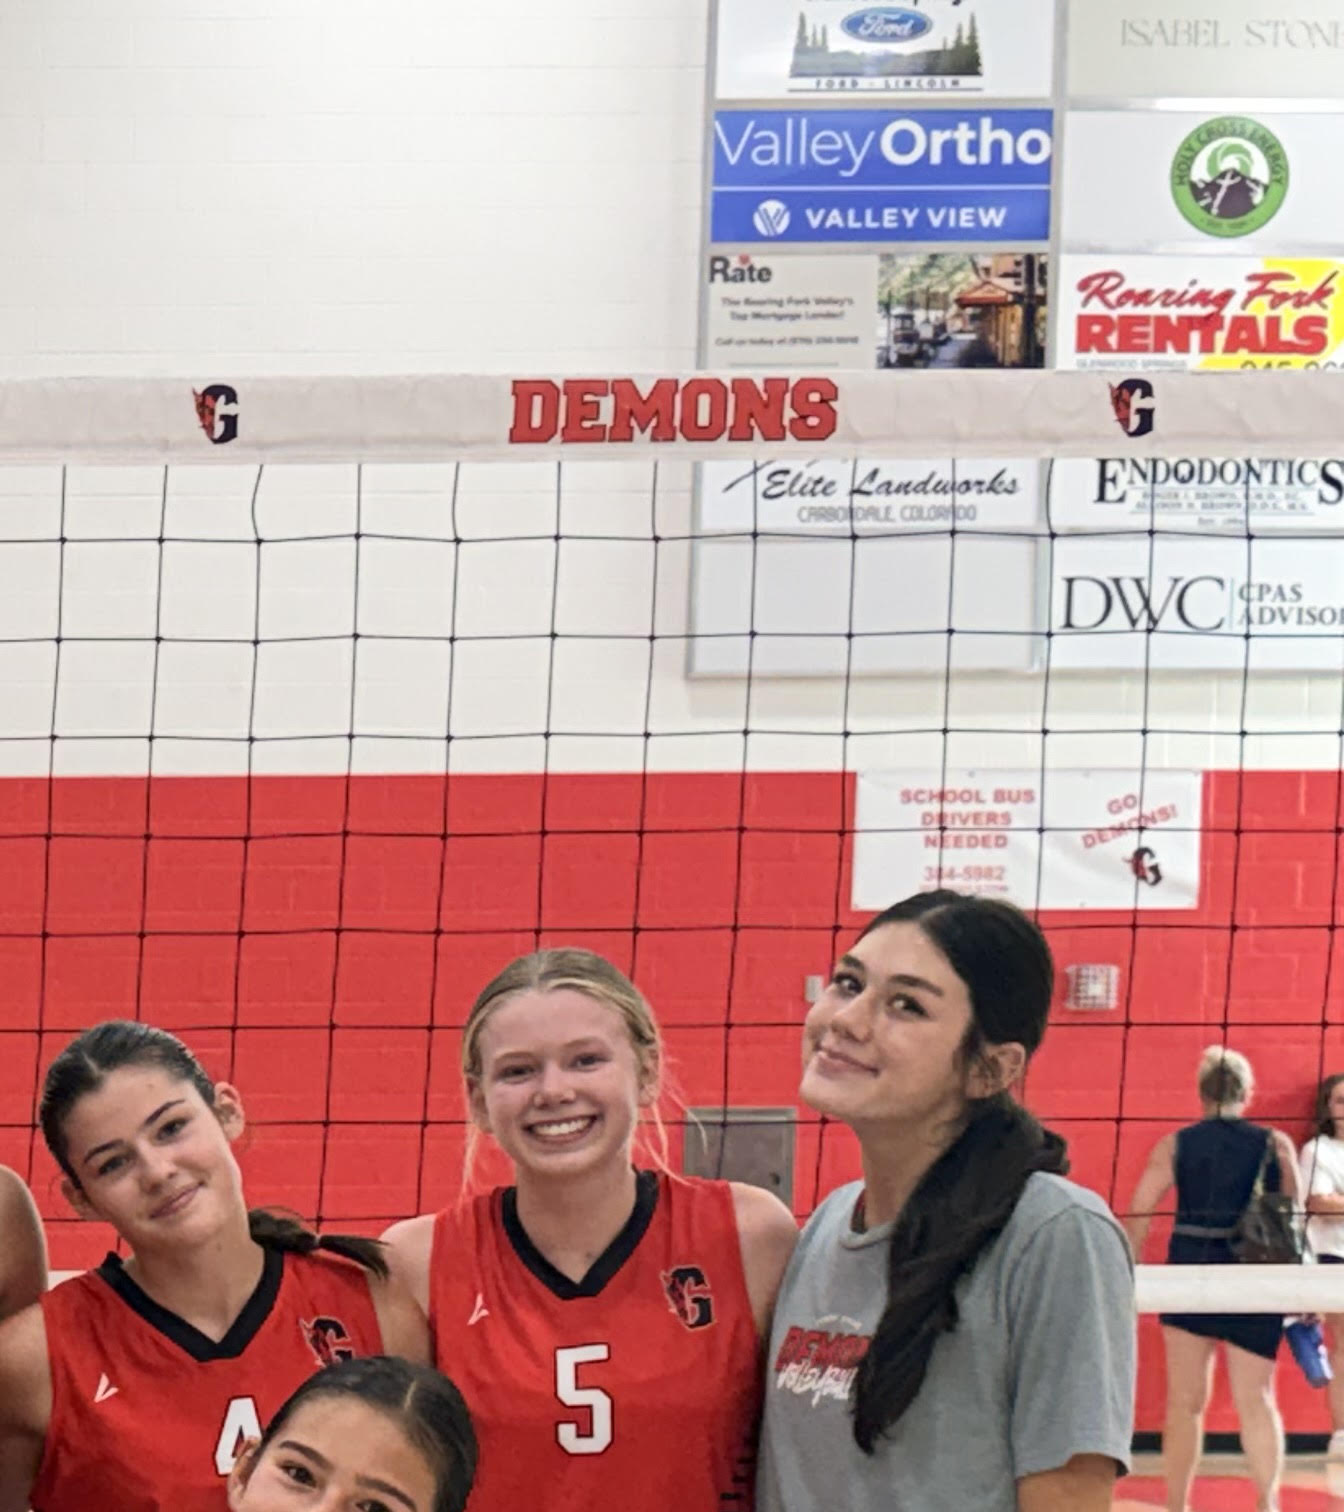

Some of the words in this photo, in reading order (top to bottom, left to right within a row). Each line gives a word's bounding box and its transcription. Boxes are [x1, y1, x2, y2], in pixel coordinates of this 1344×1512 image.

[859, 13, 915, 36] Ford
[1120, 18, 1231, 48] ISABEL
[815, 79, 859, 88] FORD
[714, 117, 875, 177] Valley
[880, 117, 1053, 165] Ortho
[806, 207, 919, 229] VALLEY
[927, 206, 1007, 229] VIEW
[708, 255, 773, 284] Rate
[1076, 270, 1236, 319] Roaring
[1240, 270, 1340, 311] Fork
[1075, 313, 1330, 355] RENTALS
[508, 377, 839, 443] DEMONS
[761, 469, 838, 500] Elite
[849, 467, 1021, 497] Landworks
[1093, 457, 1344, 505] ENDODONTICS
[1062, 576, 1226, 632] DWC
[1238, 583, 1303, 603] CPAS
[900, 789, 985, 804] SCHOOL
[994, 789, 1035, 803] BUS
[1107, 793, 1139, 816] GO
[921, 812, 1012, 826] DRIVERS
[1081, 803, 1178, 850] DEMONS!
[924, 835, 1008, 849] NEEDED
[554, 1343, 612, 1456] 5
